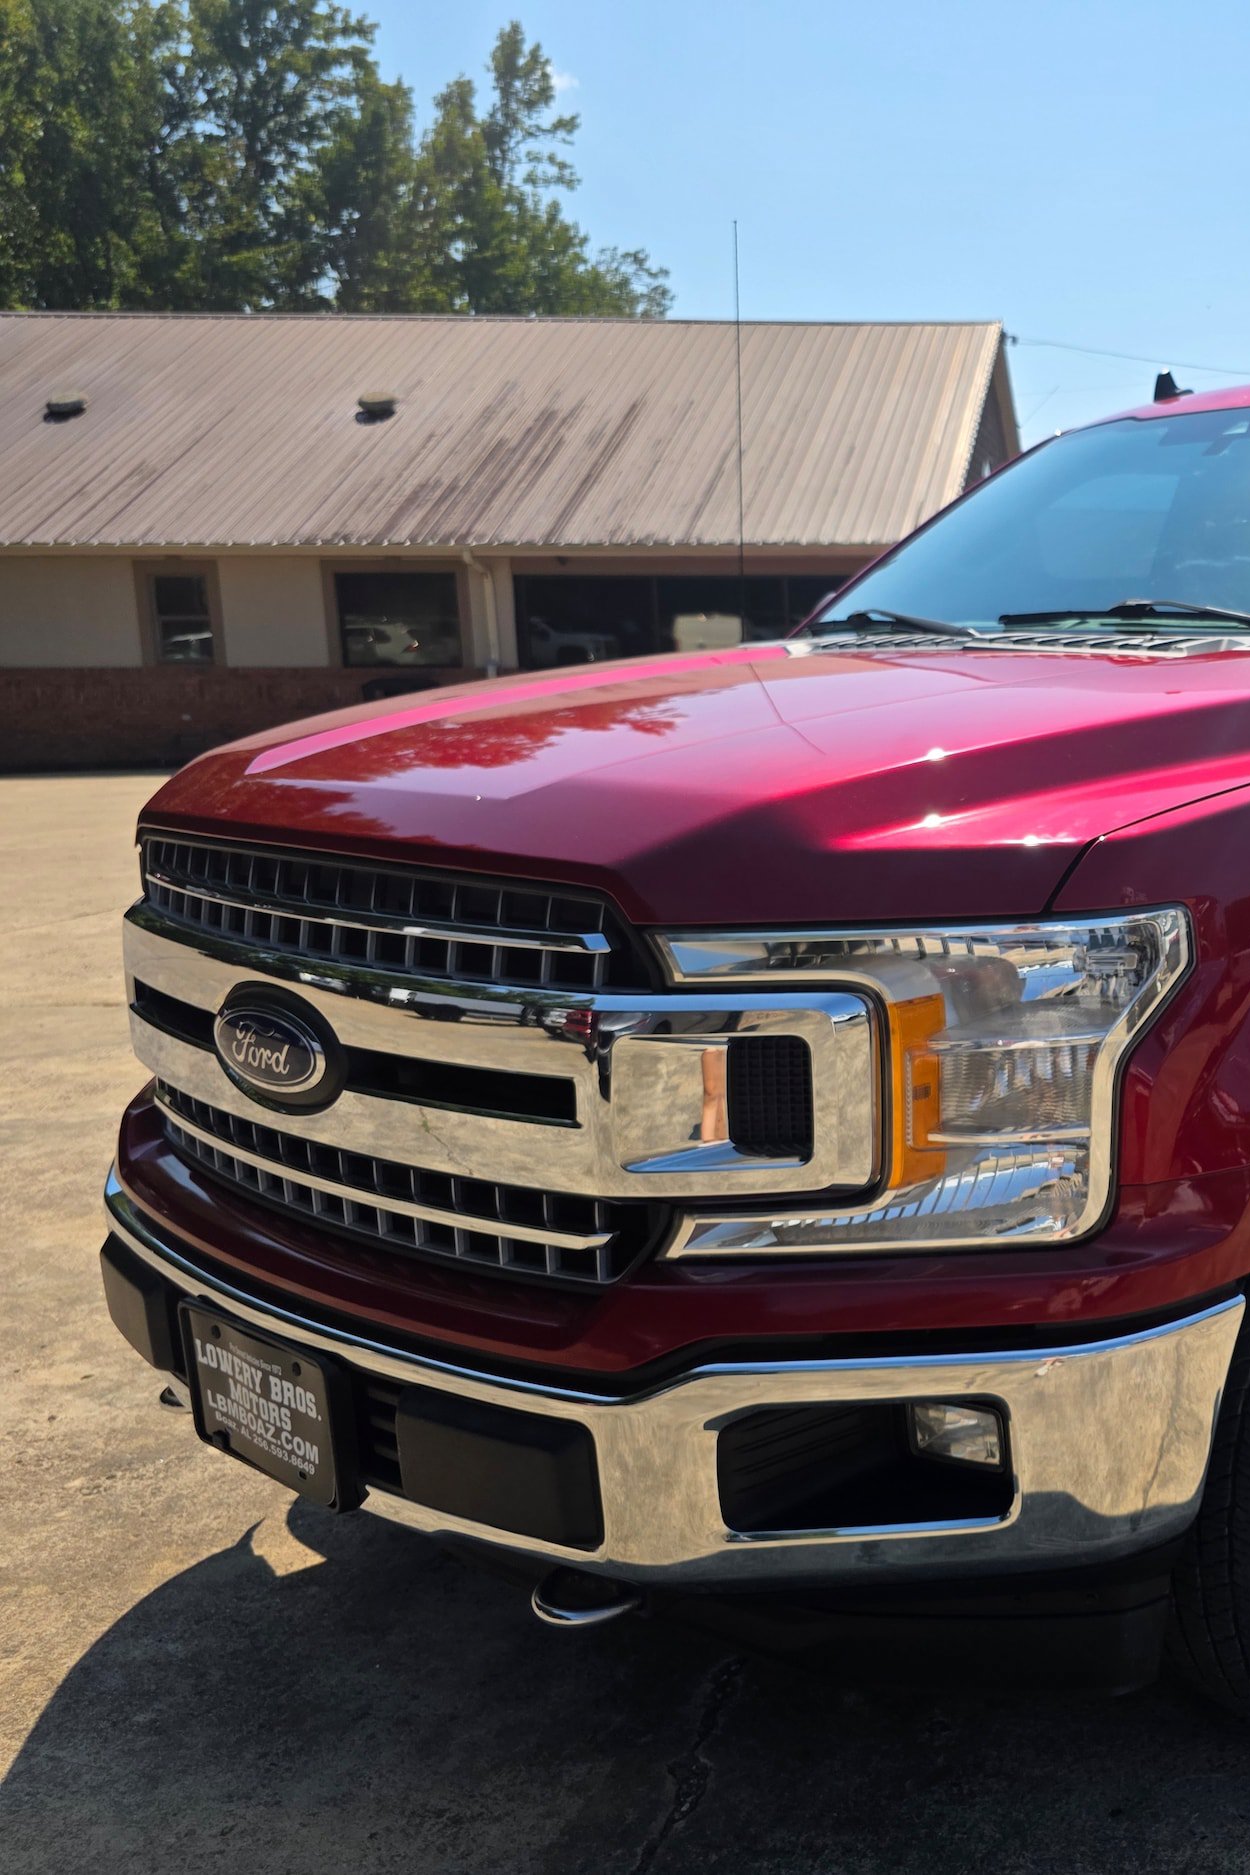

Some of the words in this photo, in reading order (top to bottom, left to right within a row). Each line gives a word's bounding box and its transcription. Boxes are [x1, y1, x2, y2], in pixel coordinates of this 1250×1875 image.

[231, 1021, 290, 1075] Ford
[194, 1338, 263, 1394] LOWERY
[268, 1374, 322, 1421] BROS.
[229, 1377, 292, 1432] MOTORS
[206, 1389, 320, 1465] LBMBOAZ.COM
